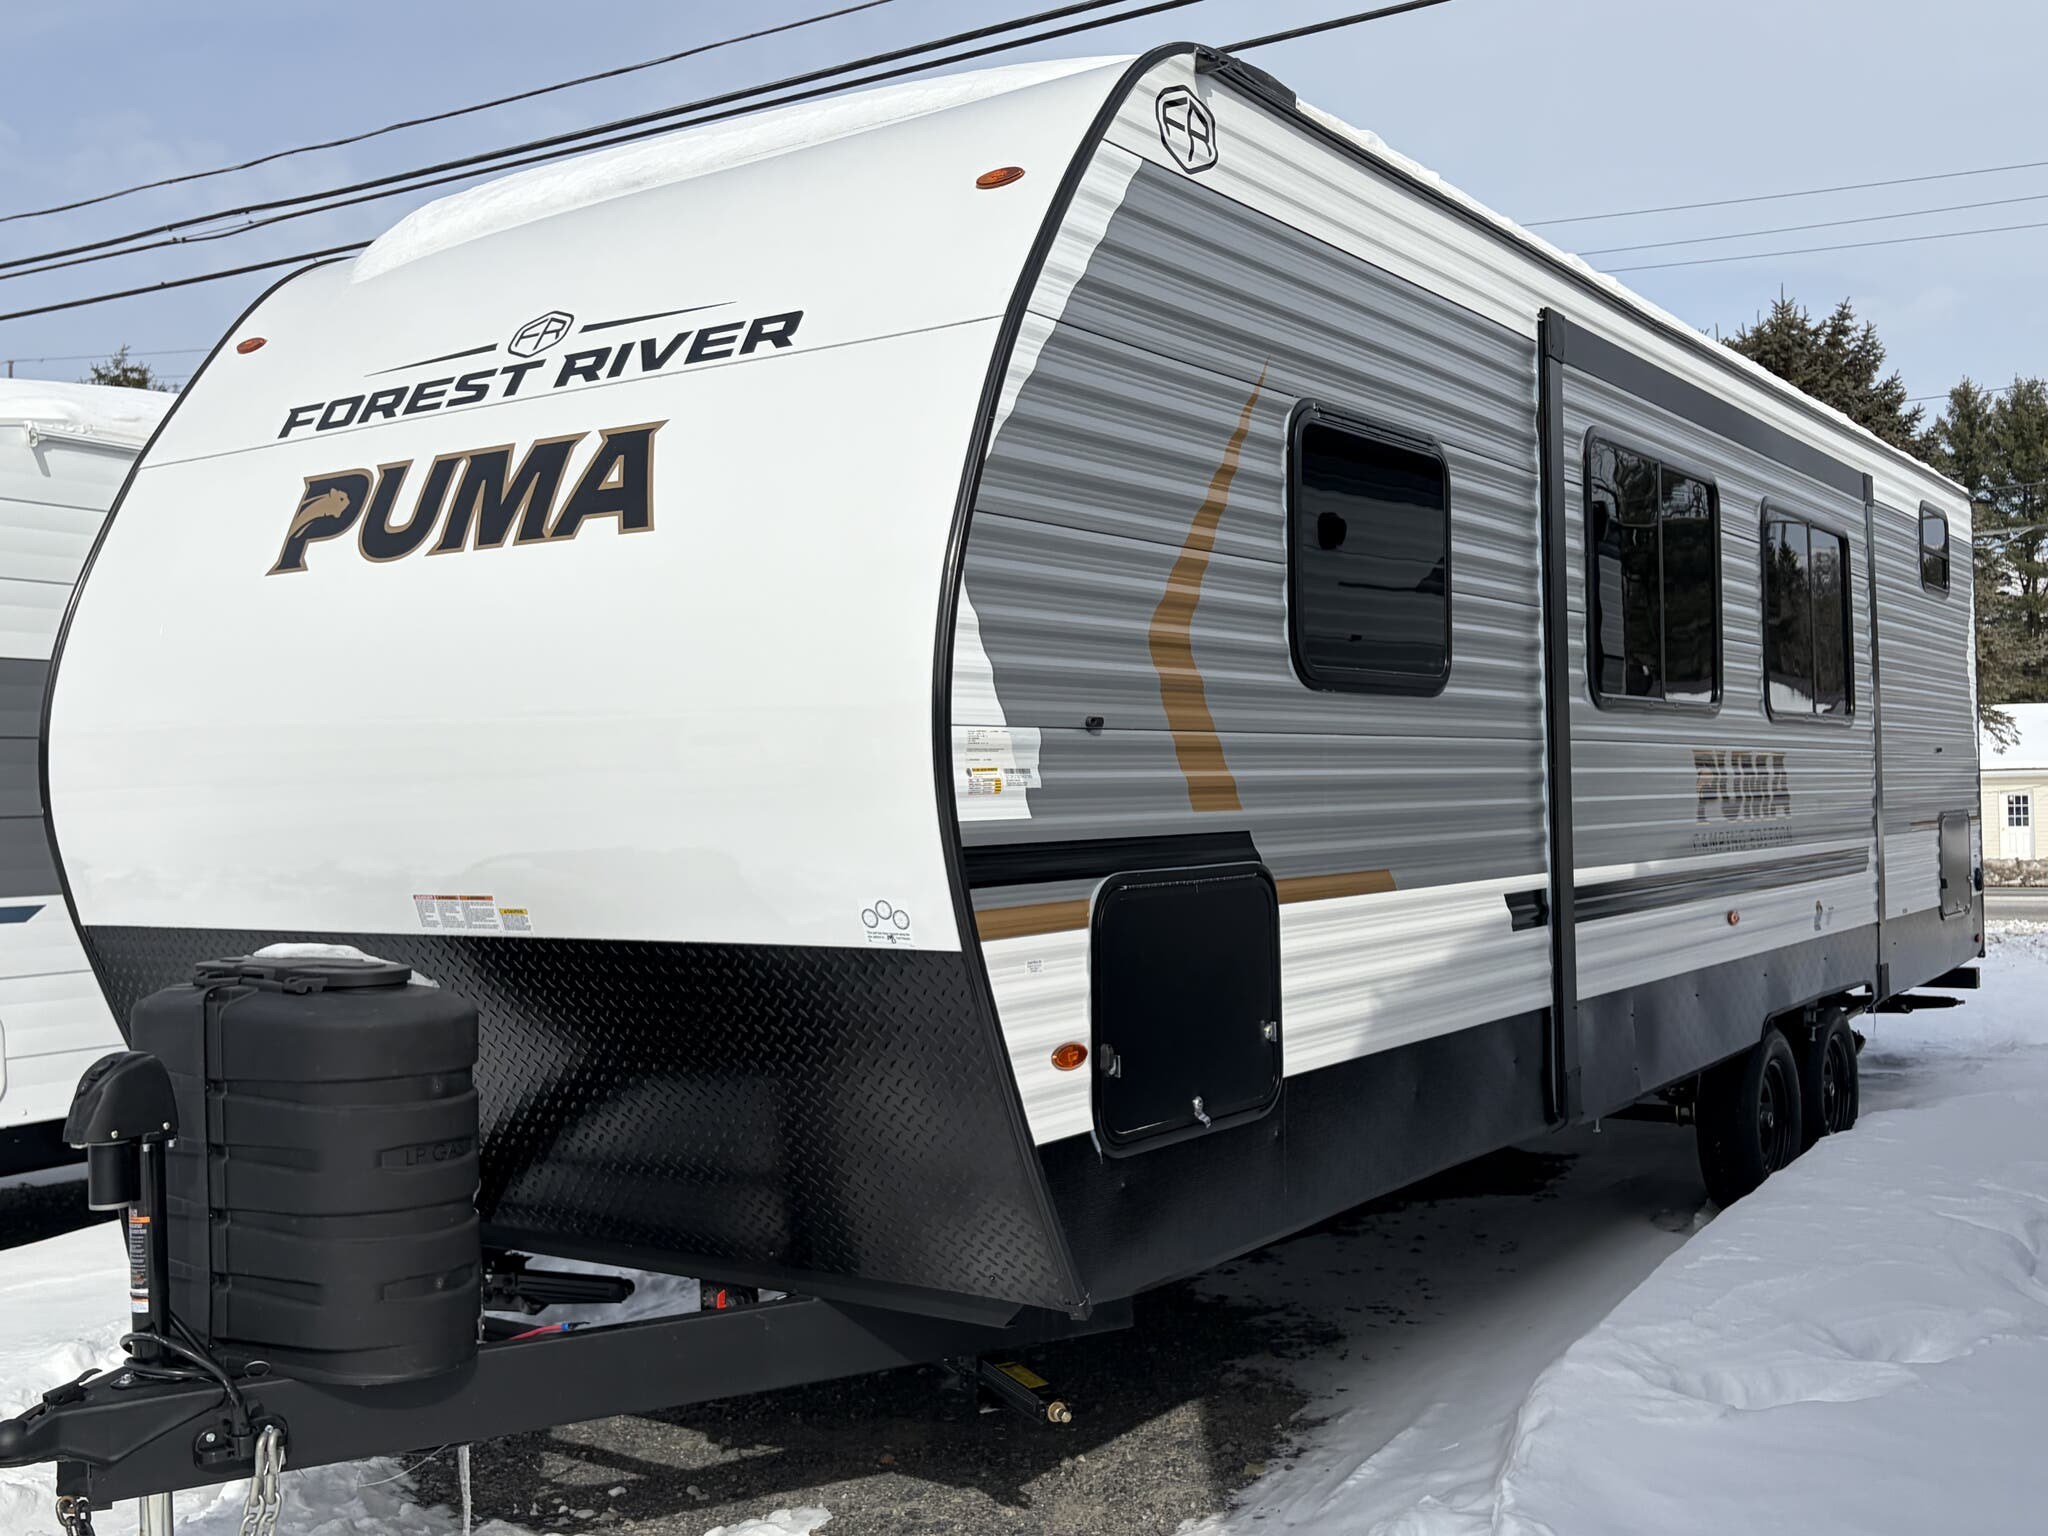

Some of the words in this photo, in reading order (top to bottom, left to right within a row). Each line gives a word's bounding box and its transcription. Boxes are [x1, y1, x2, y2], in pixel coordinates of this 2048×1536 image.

[278, 359, 545, 439] FOREST
[553, 310, 803, 388] RIVER
[265, 419, 670, 576] PUMA
[1692, 750, 1792, 825] PUMA
[405, 1147, 426, 1166] LP
